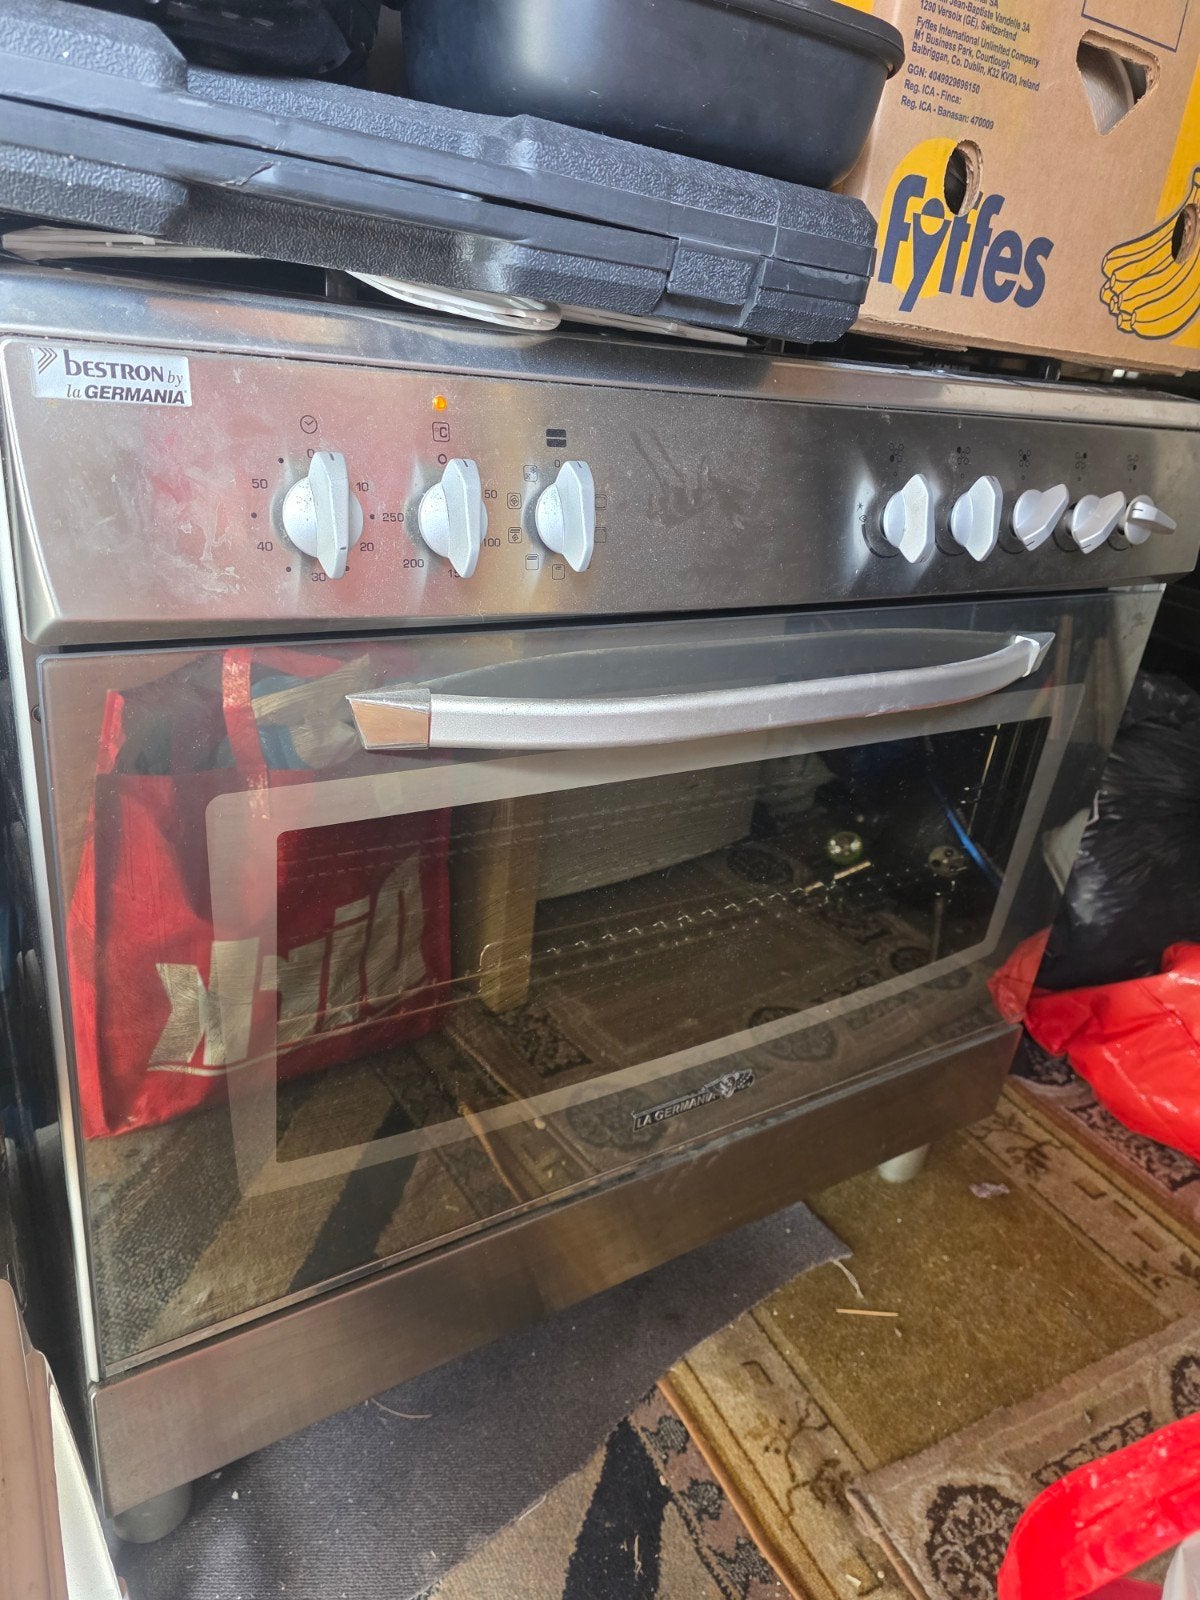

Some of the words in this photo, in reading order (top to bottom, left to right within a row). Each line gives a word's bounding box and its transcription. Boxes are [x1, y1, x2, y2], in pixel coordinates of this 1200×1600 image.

[920, 0, 936, 12] 1290
[981, 20, 1018, 41] Switzerland
[1022, 22, 1030, 33] 3A
[917, 16, 937, 32] Fyffes
[938, 23, 980, 46] International
[981, 37, 1010, 56] Unlimited
[1011, 48, 1040, 68] Company
[926, 32, 957, 51] Business
[957, 43, 974, 59] Park,
[976, 50, 1011, 70] Courtlough
[907, 63, 927, 78] GGN:
[912, 41, 949, 64] Balbriggan,
[951, 54, 962, 67] Co.
[963, 58, 986, 76] Dublin,
[987, 65, 1000, 79] K32
[1019, 76, 1041, 91] Ireland
[904, 79, 920, 94] Reg.
[922, 84, 935, 97] ICA
[940, 89, 963, 105] Finca:
[901, 95, 917, 110] Reg.
[919, 100, 932, 113] ICA
[167, 370, 184, 387] by
[66, 384, 82, 398] la
[84, 384, 186, 404] GERMANIA
[251, 479, 268, 489] 50
[356, 482, 369, 492] 10
[484, 490, 498, 499] 50
[382, 513, 405, 522] 250
[256, 541, 273, 551] 40
[360, 542, 375, 552] 20
[483, 538, 501, 547] 100
[403, 559, 425, 568] 200
[311, 572, 327, 582] 30
[637, 1114, 651, 1129] LA
[654, 1092, 717, 1122] GERMANIA
